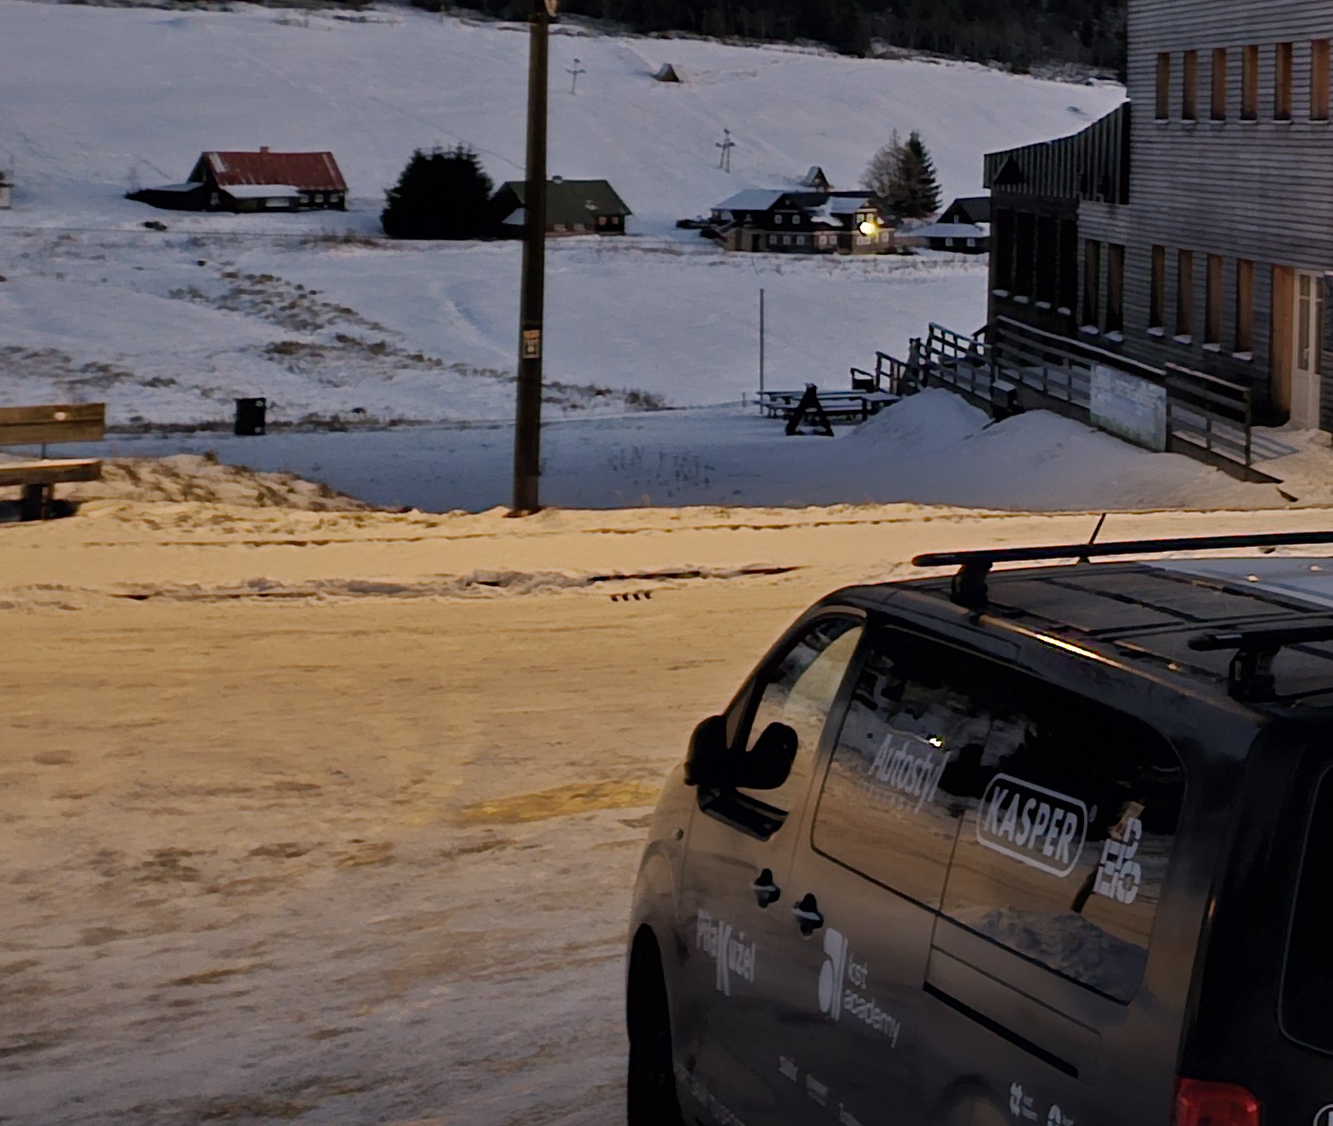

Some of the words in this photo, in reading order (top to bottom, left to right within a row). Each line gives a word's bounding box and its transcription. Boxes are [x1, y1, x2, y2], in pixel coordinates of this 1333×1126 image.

[867, 732, 953, 815] Autostyl
[984, 785, 1078, 865] KASPER
[843, 988, 901, 1049] academy
